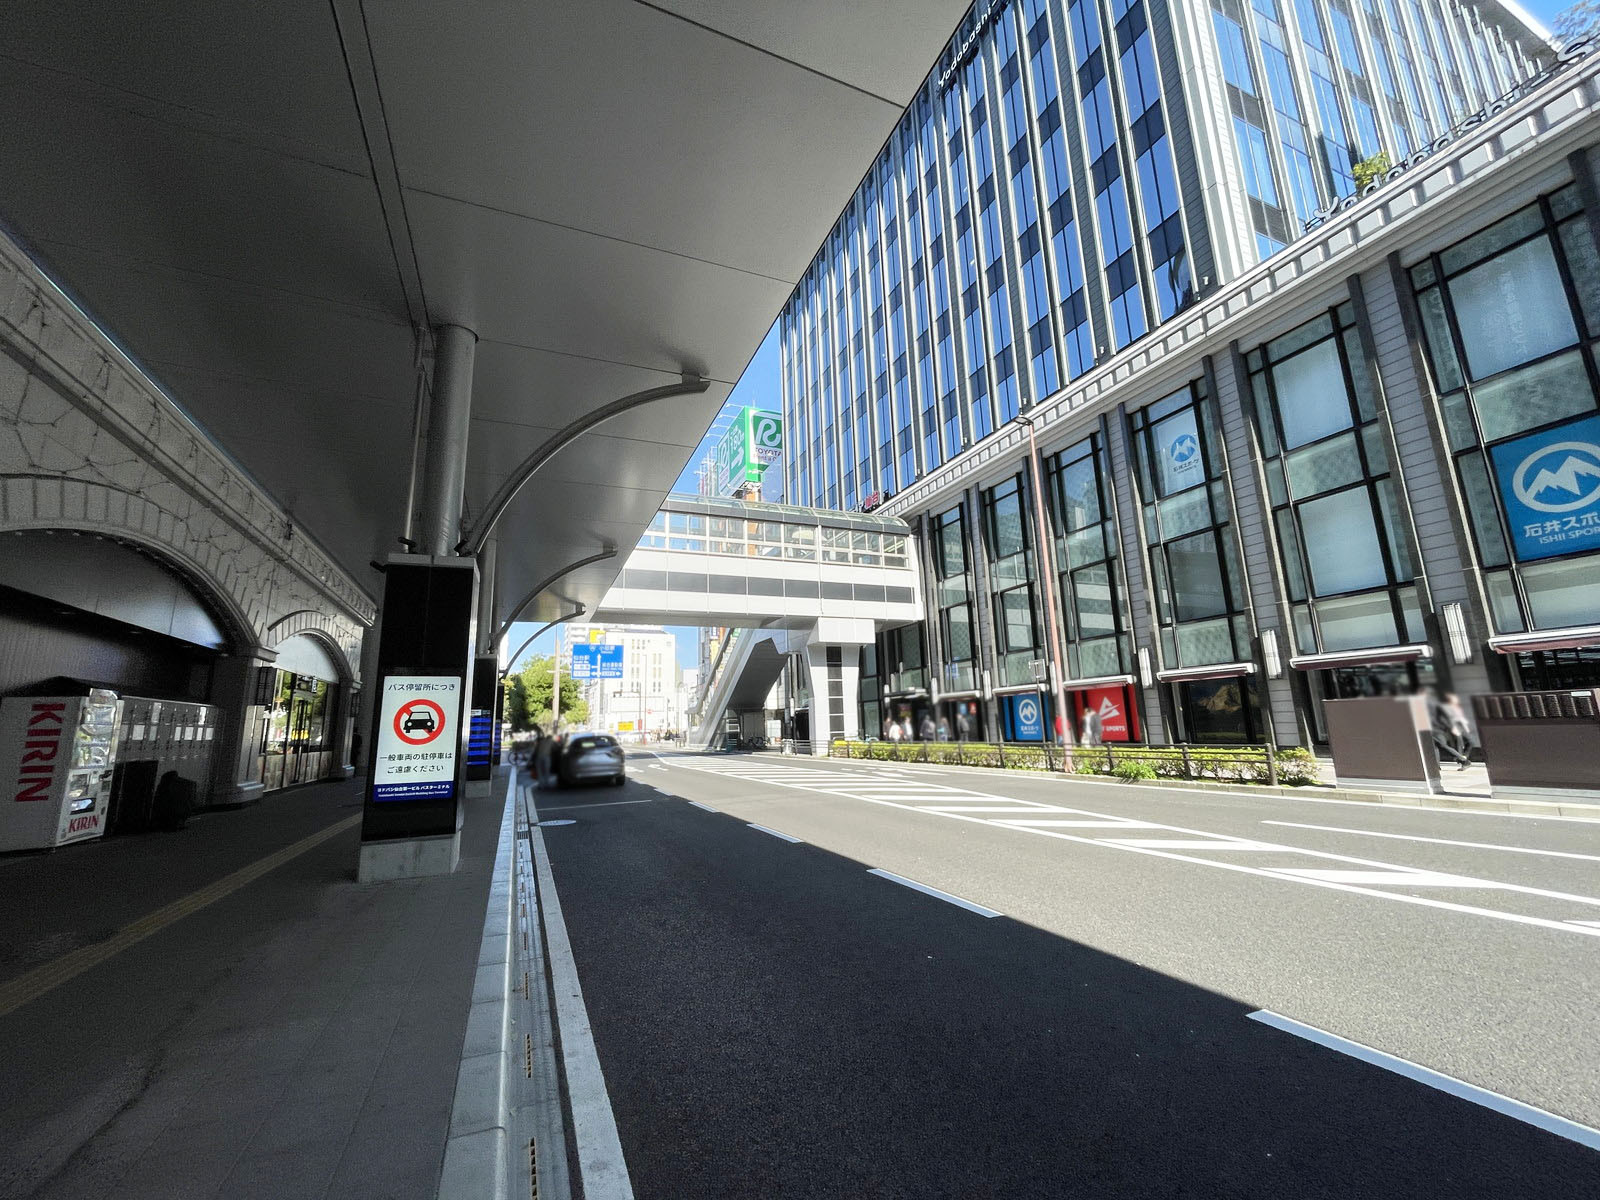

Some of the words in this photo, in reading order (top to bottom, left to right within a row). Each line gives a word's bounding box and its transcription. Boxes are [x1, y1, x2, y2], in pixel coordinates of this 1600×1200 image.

[1312, 80, 1521, 219] Yodobashi
[1539, 532, 1566, 544] ISHII
[388, 683, 455, 691] バス停留所につき
[16, 703, 66, 801] KIRIN
[380, 752, 452, 761] 一般車両の駐停車は
[387, 765, 444, 774] ご遠慮ください
[68, 814, 99, 833] KIRIN
